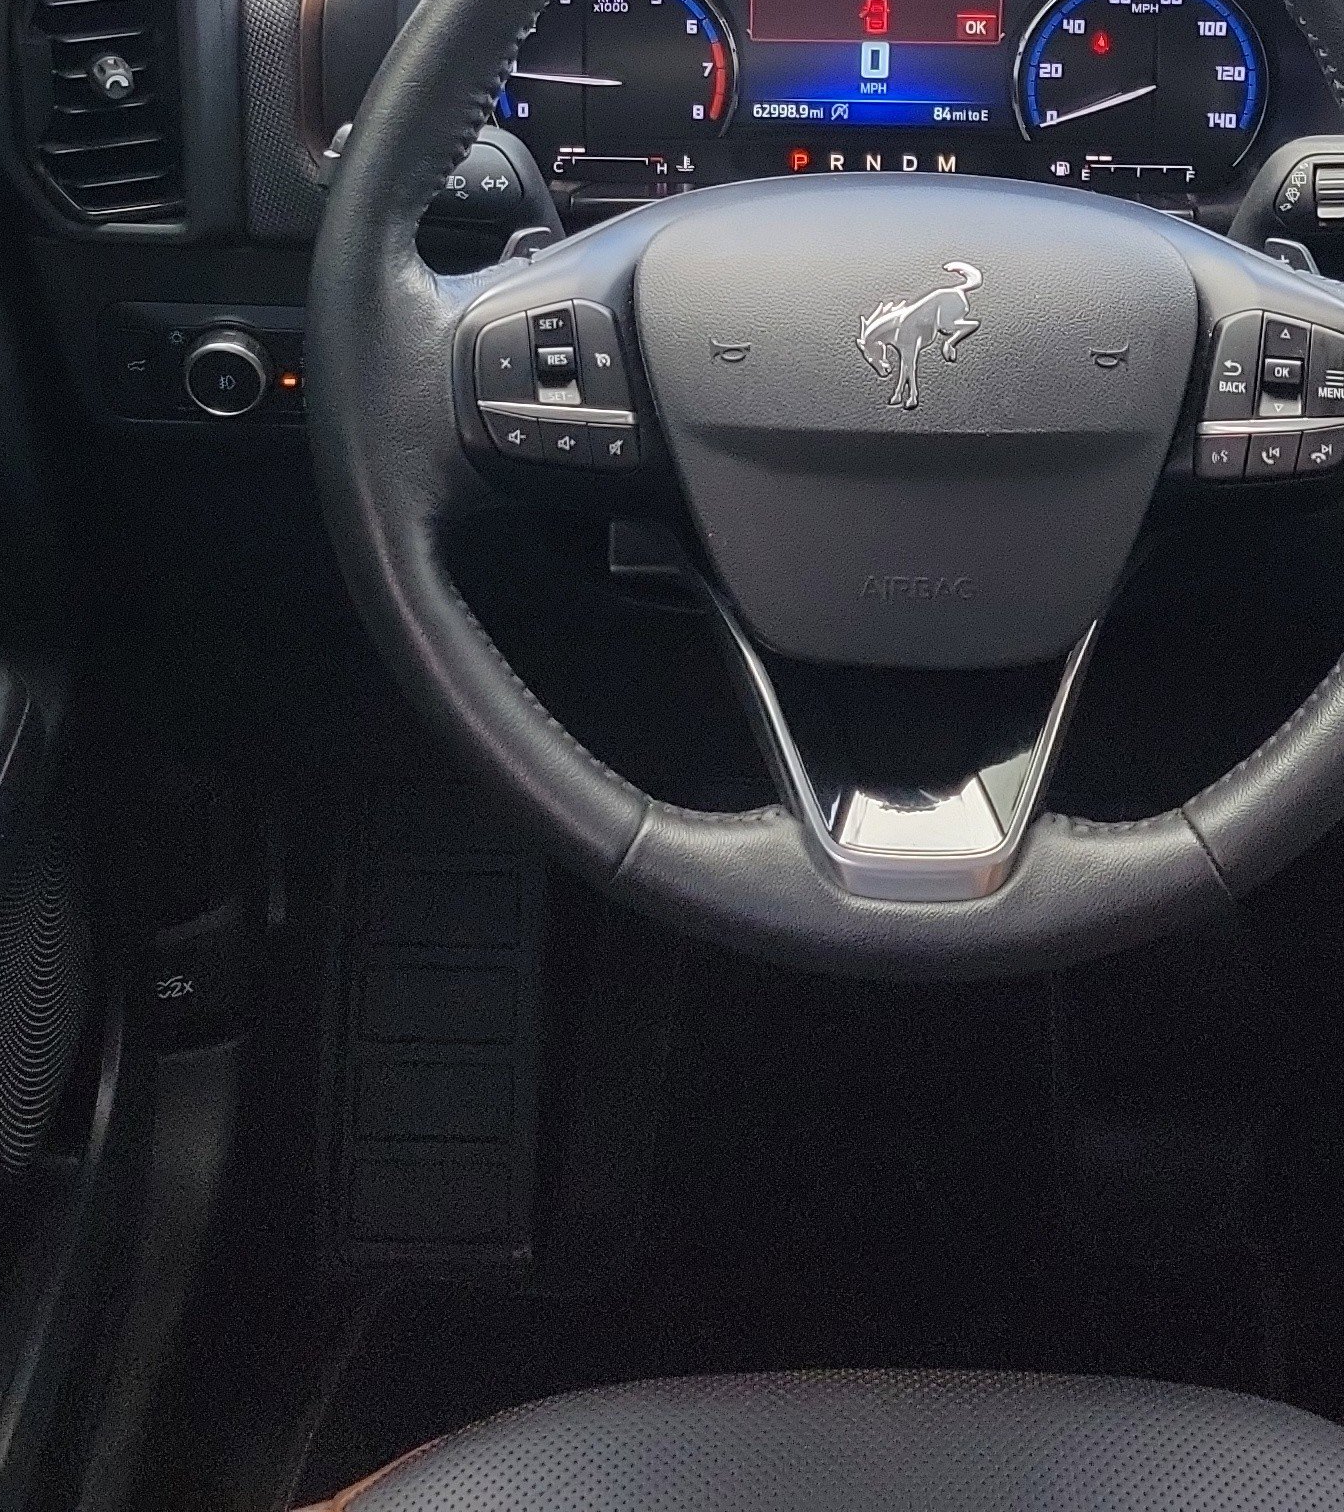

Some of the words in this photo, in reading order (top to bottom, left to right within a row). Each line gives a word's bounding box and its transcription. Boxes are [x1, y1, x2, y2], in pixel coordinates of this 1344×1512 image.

[593, 2, 628, 13] x1000
[1131, 3, 1159, 14] MPH
[687, 19, 698, 34] 6
[965, 20, 987, 35] OK
[1062, 19, 1085, 34] 40
[1197, 21, 1227, 36] 100
[861, 41, 889, 79] 0
[702, 62, 713, 77] 7
[1039, 63, 1063, 78] 20
[1215, 66, 1246, 81] 120
[860, 82, 887, 94] MPH
[517, 103, 529, 118] 0
[692, 105, 704, 120] 8
[933, 106, 951, 121] 84
[1046, 110, 1058, 125] 0
[1207, 112, 1237, 129] 140
[553, 161, 564, 173] C
[656, 163, 668, 174] H
[792, 153, 808, 170] P
[830, 154, 844, 170] R
[866, 154, 881, 171] N
[903, 155, 918, 171] D
[937, 155, 956, 172] M
[1081, 169, 1090, 181] E
[1186, 170, 1195, 182] F
[547, 354, 568, 366] RES
[1274, 366, 1290, 378] OK
[1218, 380, 1247, 393] BACK
[858, 575, 975, 600] AIRBAG
